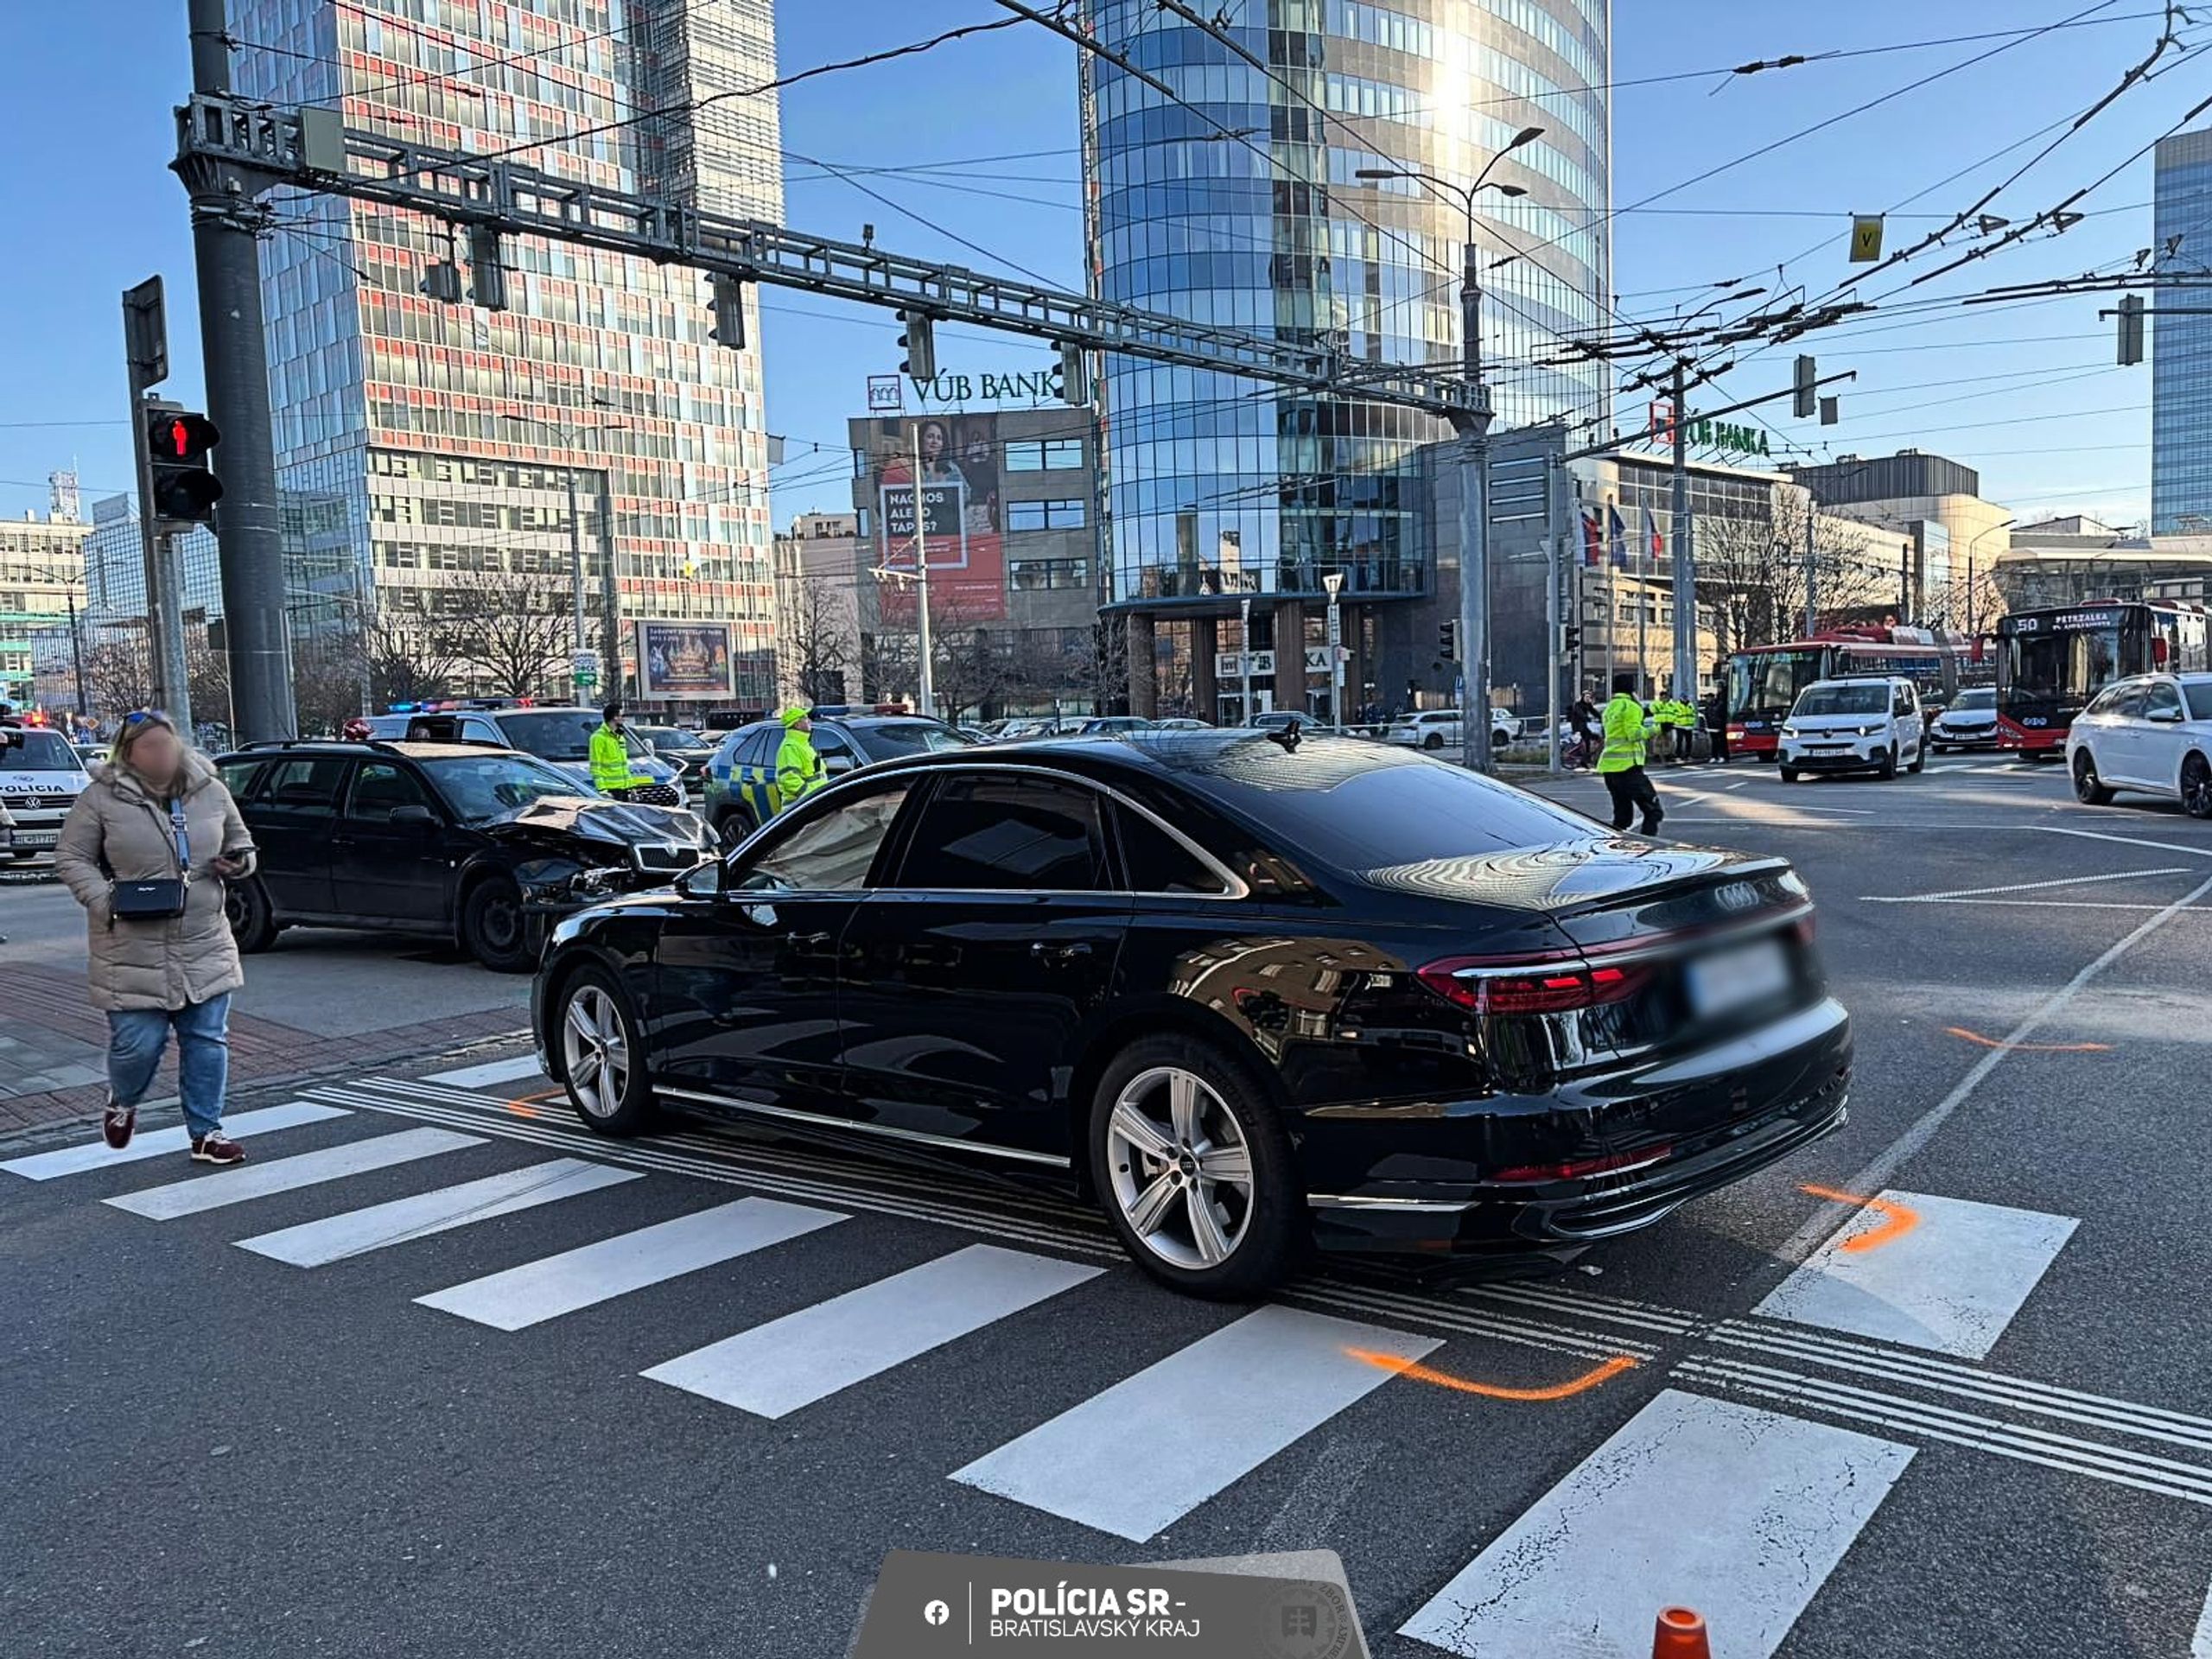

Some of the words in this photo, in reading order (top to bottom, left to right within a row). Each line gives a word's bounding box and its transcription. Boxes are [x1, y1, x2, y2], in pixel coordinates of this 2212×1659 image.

[912, 367, 972, 403] VÚB
[980, 370, 1058, 399] BANK
[1685, 408, 1712, 447] ÚB
[1715, 422, 1770, 458] BANKA
[889, 492, 944, 505] NACOS
[889, 507, 931, 519] ALEO
[890, 520, 938, 533] TAPS?
[2017, 617, 2038, 634] 50
